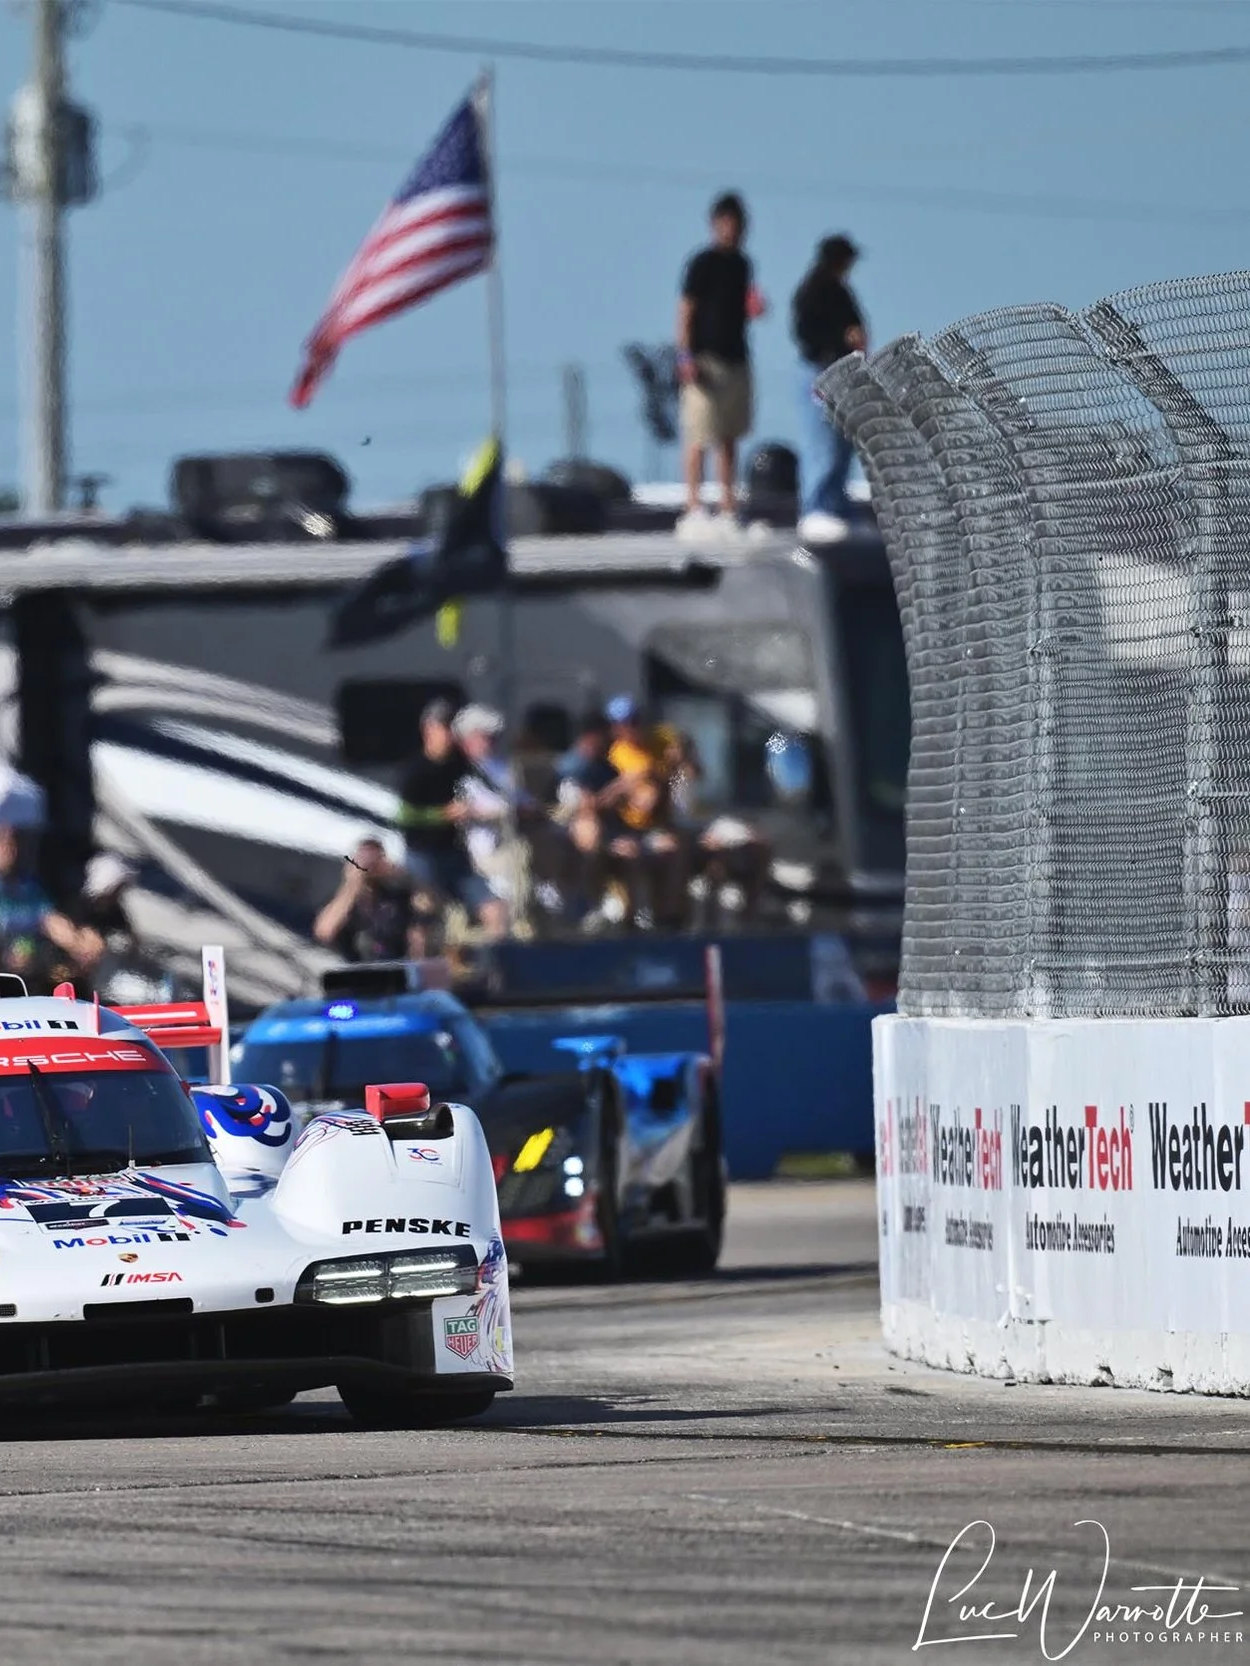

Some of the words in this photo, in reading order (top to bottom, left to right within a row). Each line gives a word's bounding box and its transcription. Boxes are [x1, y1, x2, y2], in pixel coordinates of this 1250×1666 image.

[1148, 1102, 1250, 1192] Weather
[69, 1199, 121, 1218] 7
[342, 1218, 471, 1238] PENSKE
[1176, 1214, 1222, 1258] Automotive
[53, 1234, 151, 1249] Mobil
[126, 1272, 183, 1284] IMSA
[448, 1320, 476, 1333] TAG
[447, 1335, 478, 1355] HEUER
